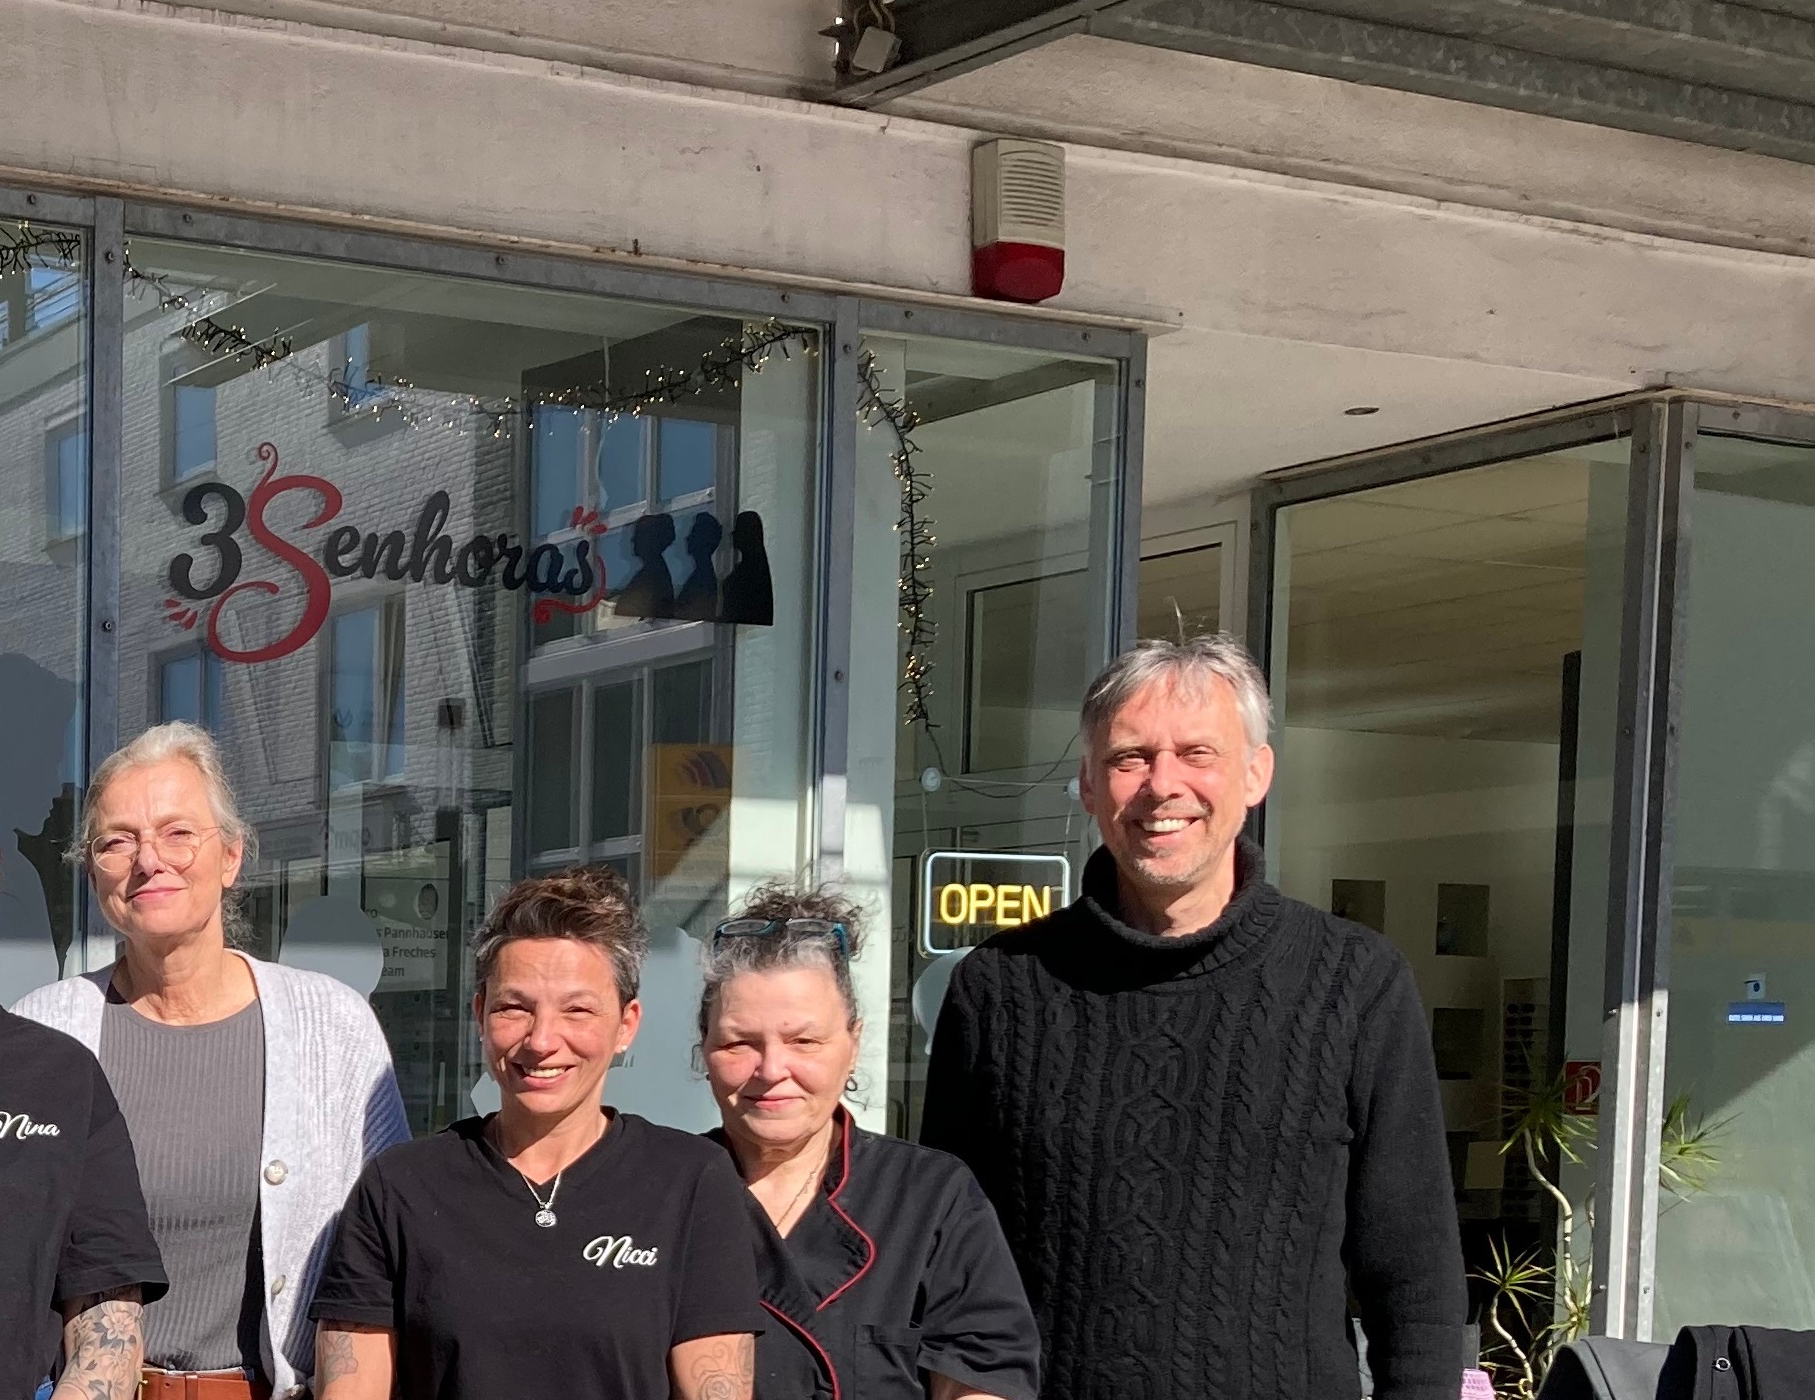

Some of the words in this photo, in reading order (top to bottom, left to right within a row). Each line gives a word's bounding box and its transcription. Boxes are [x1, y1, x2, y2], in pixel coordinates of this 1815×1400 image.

[170, 482, 246, 600] 3
[207, 442, 605, 663] Senhoras
[940, 883, 1051, 925] OPEN
[392, 946, 436, 959] Freches
[582, 1235, 658, 1269] Nicci
